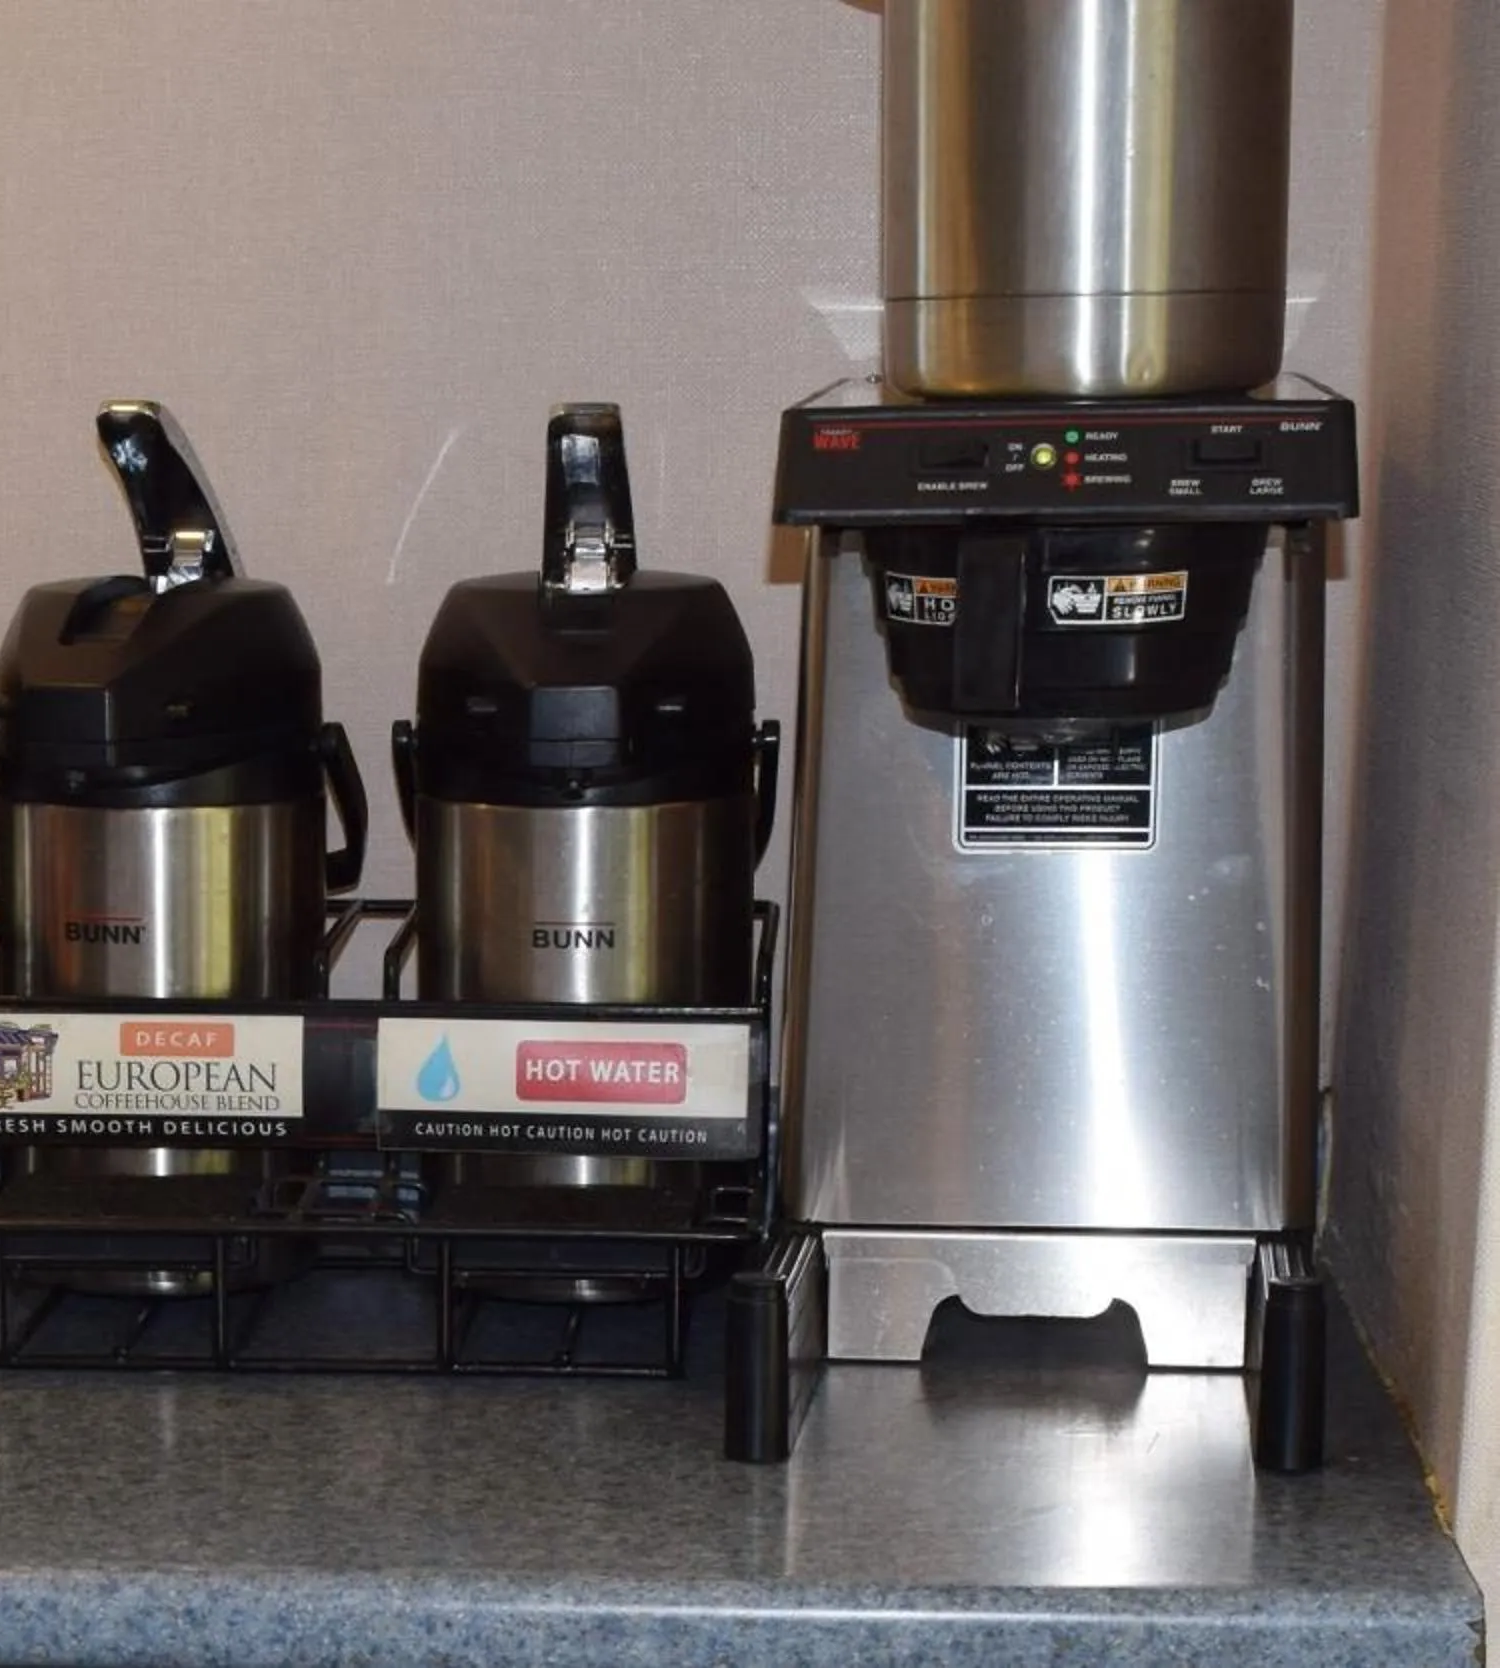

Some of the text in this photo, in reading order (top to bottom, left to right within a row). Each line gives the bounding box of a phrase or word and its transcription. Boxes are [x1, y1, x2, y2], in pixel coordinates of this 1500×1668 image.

[1211, 425, 1243, 434] START
[1280, 420, 1322, 432] BUNN
[813, 433, 861, 449] WAVE
[1085, 432, 1118, 440] READY
[1084, 453, 1128, 462] HEATING
[917, 481, 988, 491] ENABLE BREW
[1111, 603, 1177, 619] SLOWLY
[65, 921, 144, 945] BUNN
[532, 928, 615, 950] BUNN
[135, 1031, 219, 1048] DECAF
[77, 1060, 277, 1093] EUROPEAN
[525, 1059, 680, 1084] HOT WATER
[74, 1093, 281, 1112] COFFEEHOUSE BLEND
[56, 1119, 152, 1135] SMOOTH
[163, 1121, 288, 1137] DELICIOUS
[415, 1122, 708, 1144] CAUTION HOT CAUTION HOT CAUTION
